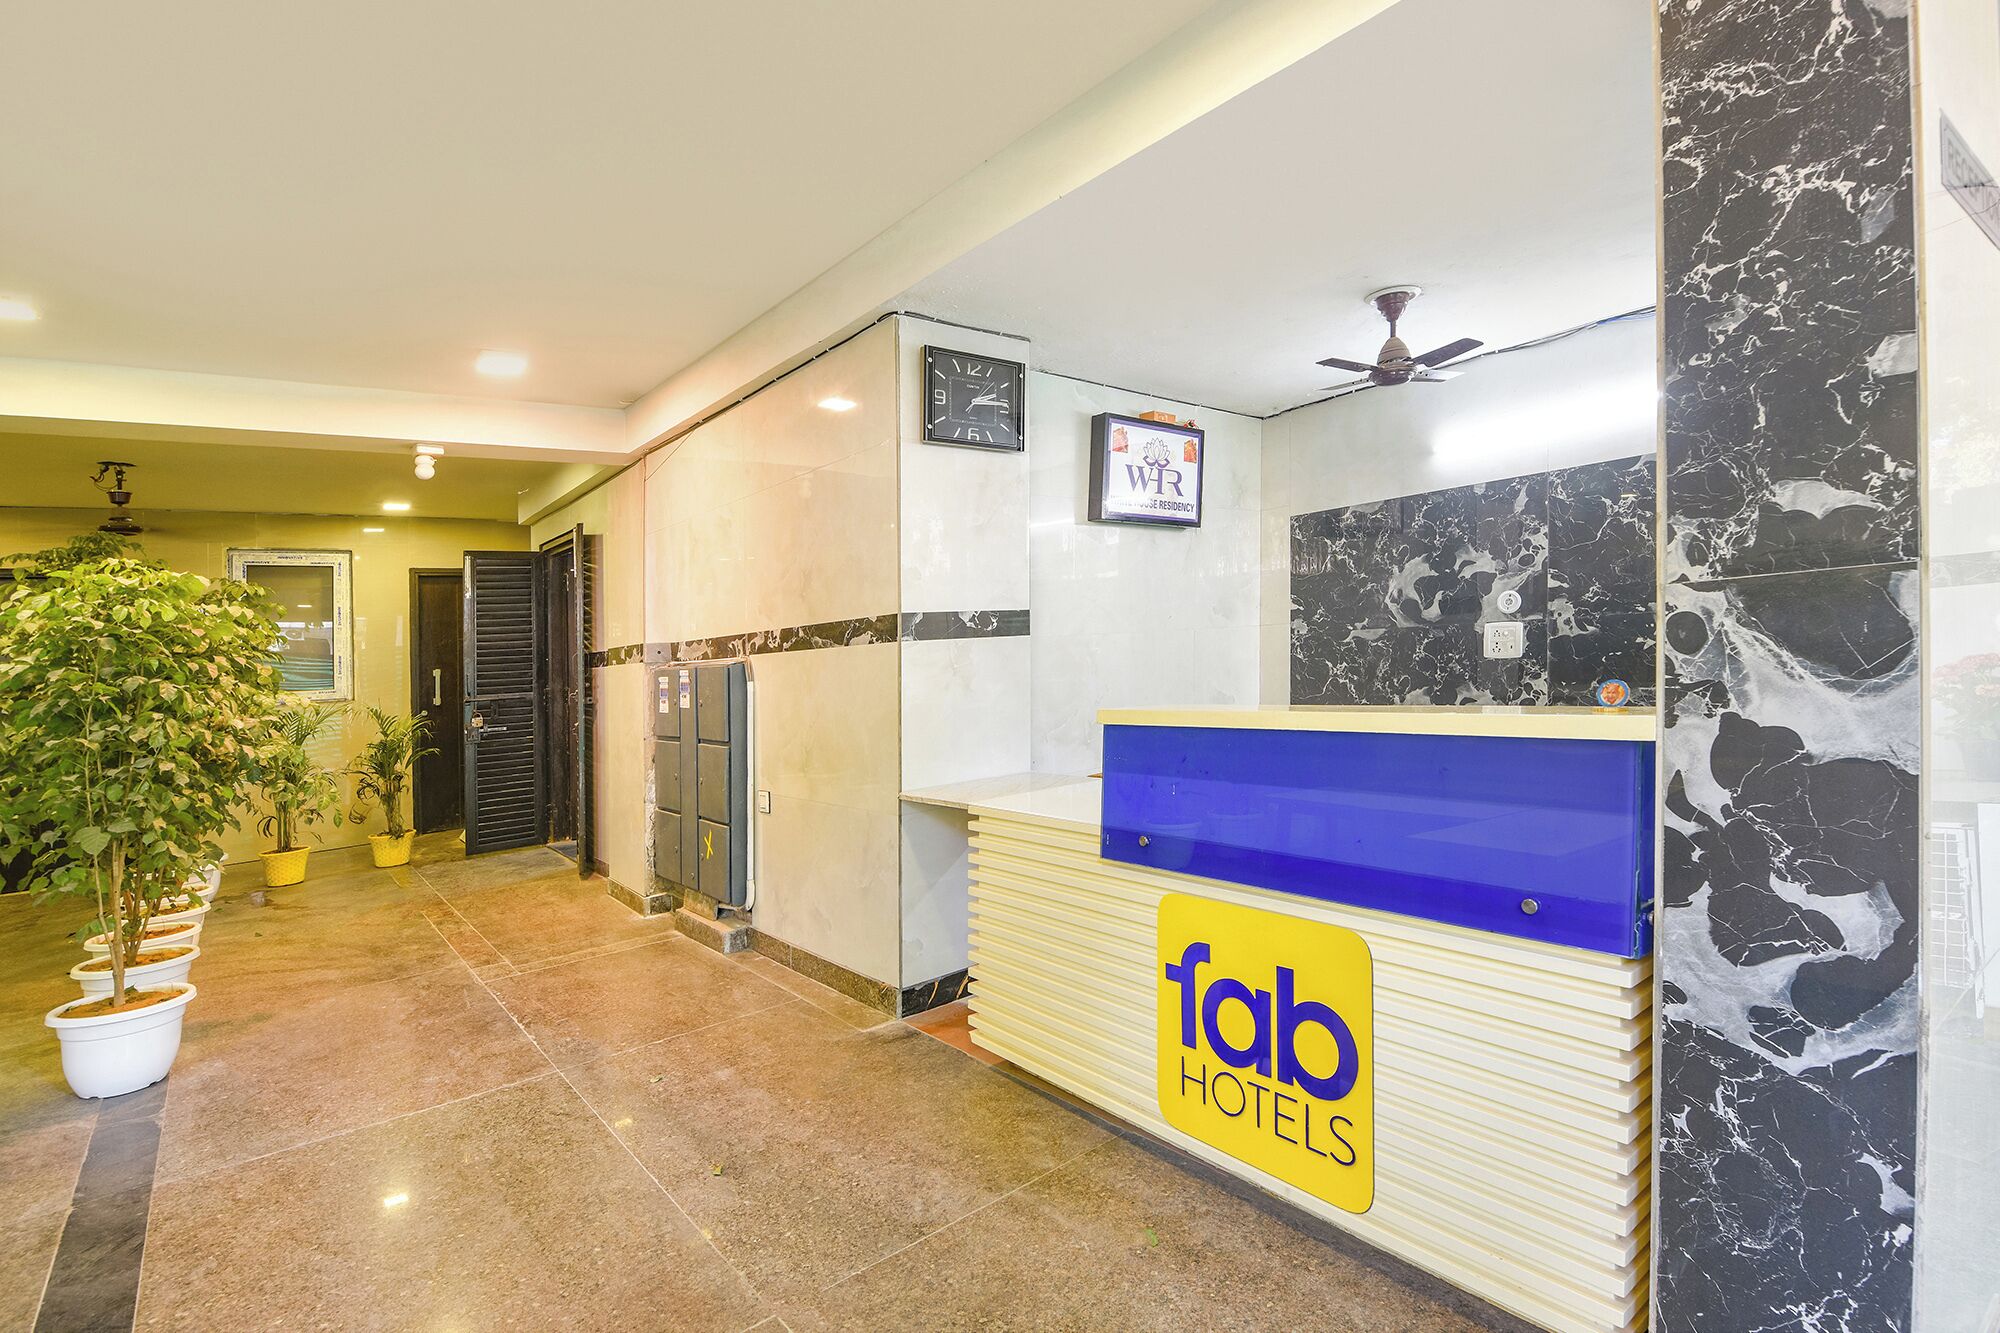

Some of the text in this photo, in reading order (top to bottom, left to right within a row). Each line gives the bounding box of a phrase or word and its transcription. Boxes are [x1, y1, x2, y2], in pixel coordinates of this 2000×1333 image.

[966, 362, 982, 377] 12
[935, 389, 946, 405] 9
[967, 427, 980, 441] 6
[1159, 500, 1195, 513] RESIDENCY
[1165, 941, 1359, 1101] fab
[1181, 1055, 1356, 1166] HOTELS
